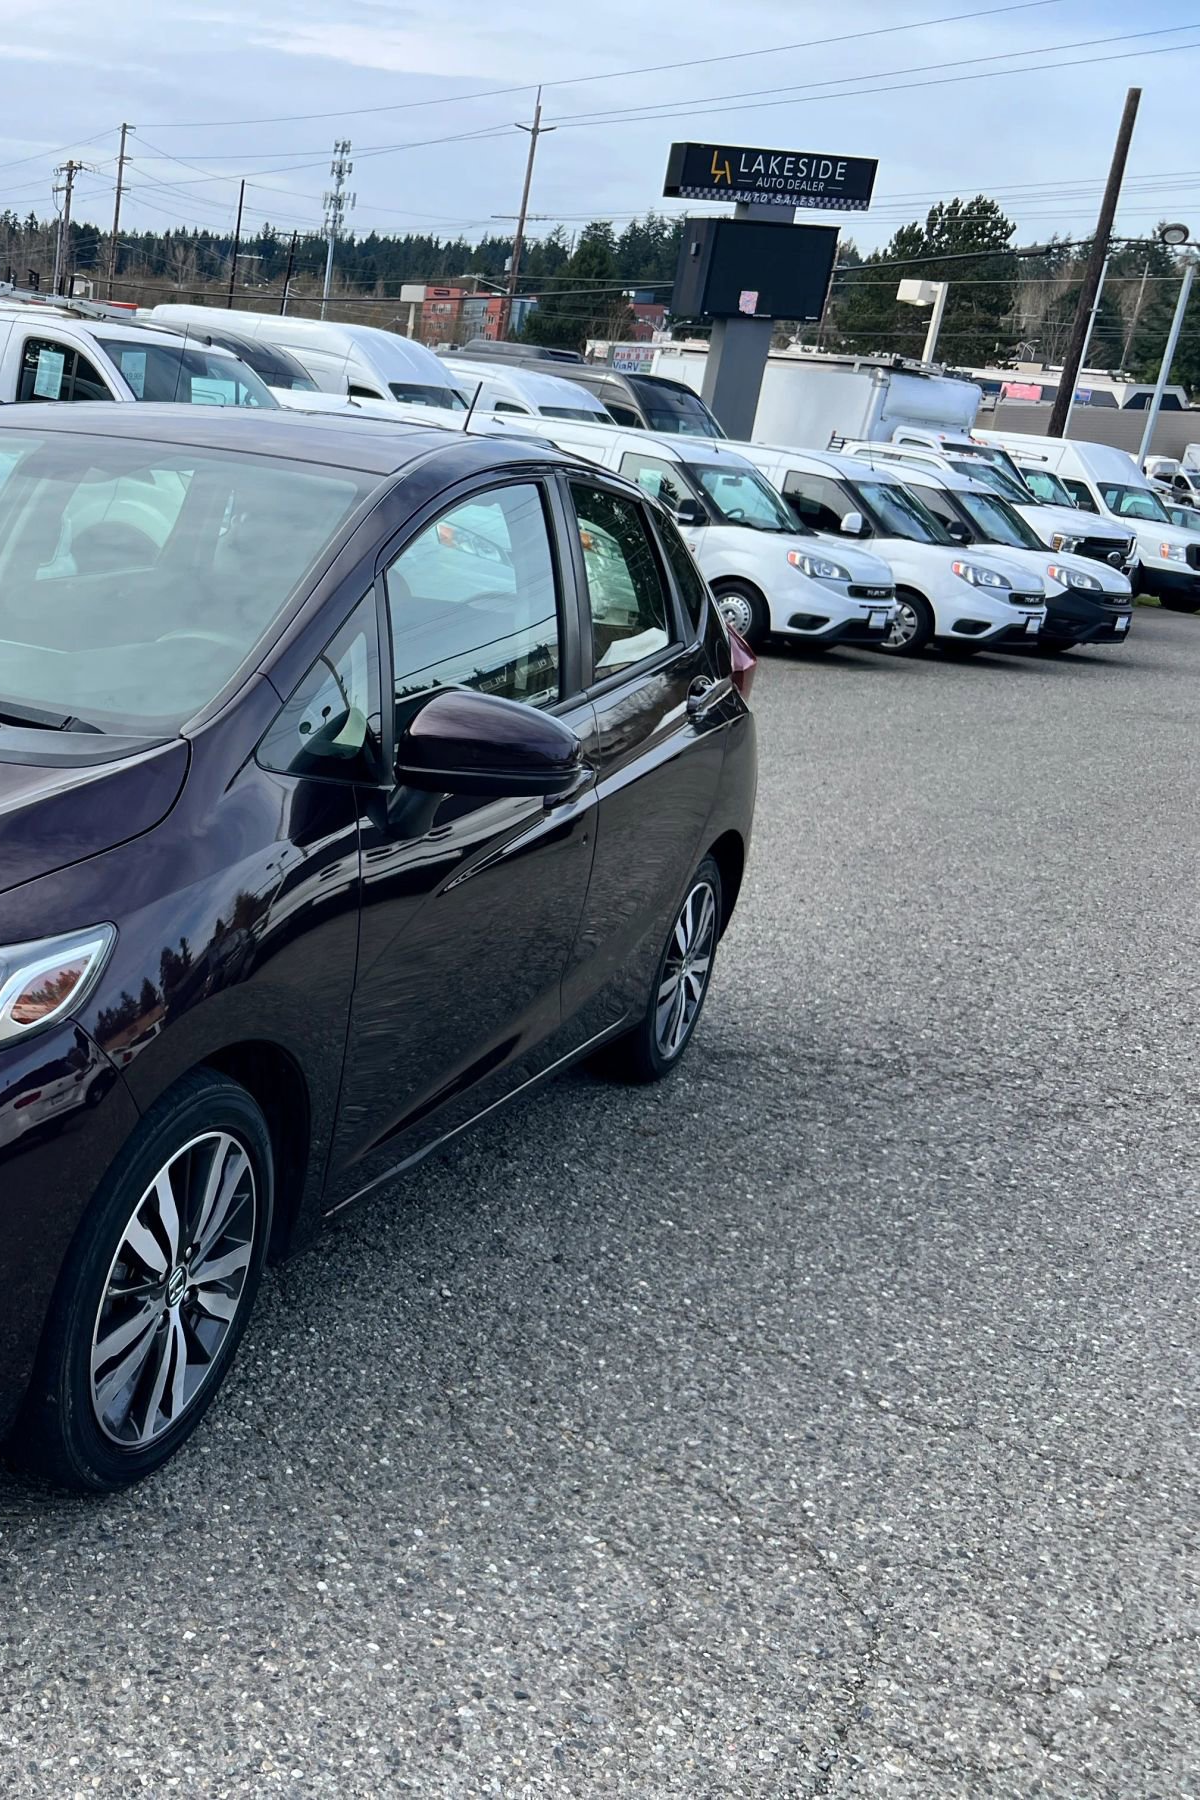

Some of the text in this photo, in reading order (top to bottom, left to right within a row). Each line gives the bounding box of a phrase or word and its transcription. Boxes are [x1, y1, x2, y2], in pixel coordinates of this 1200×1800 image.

[739, 153, 848, 181] LAKESIDE
[756, 177, 825, 192] AUTO DEALER
[733, 192, 816, 206] AUTO SALES
